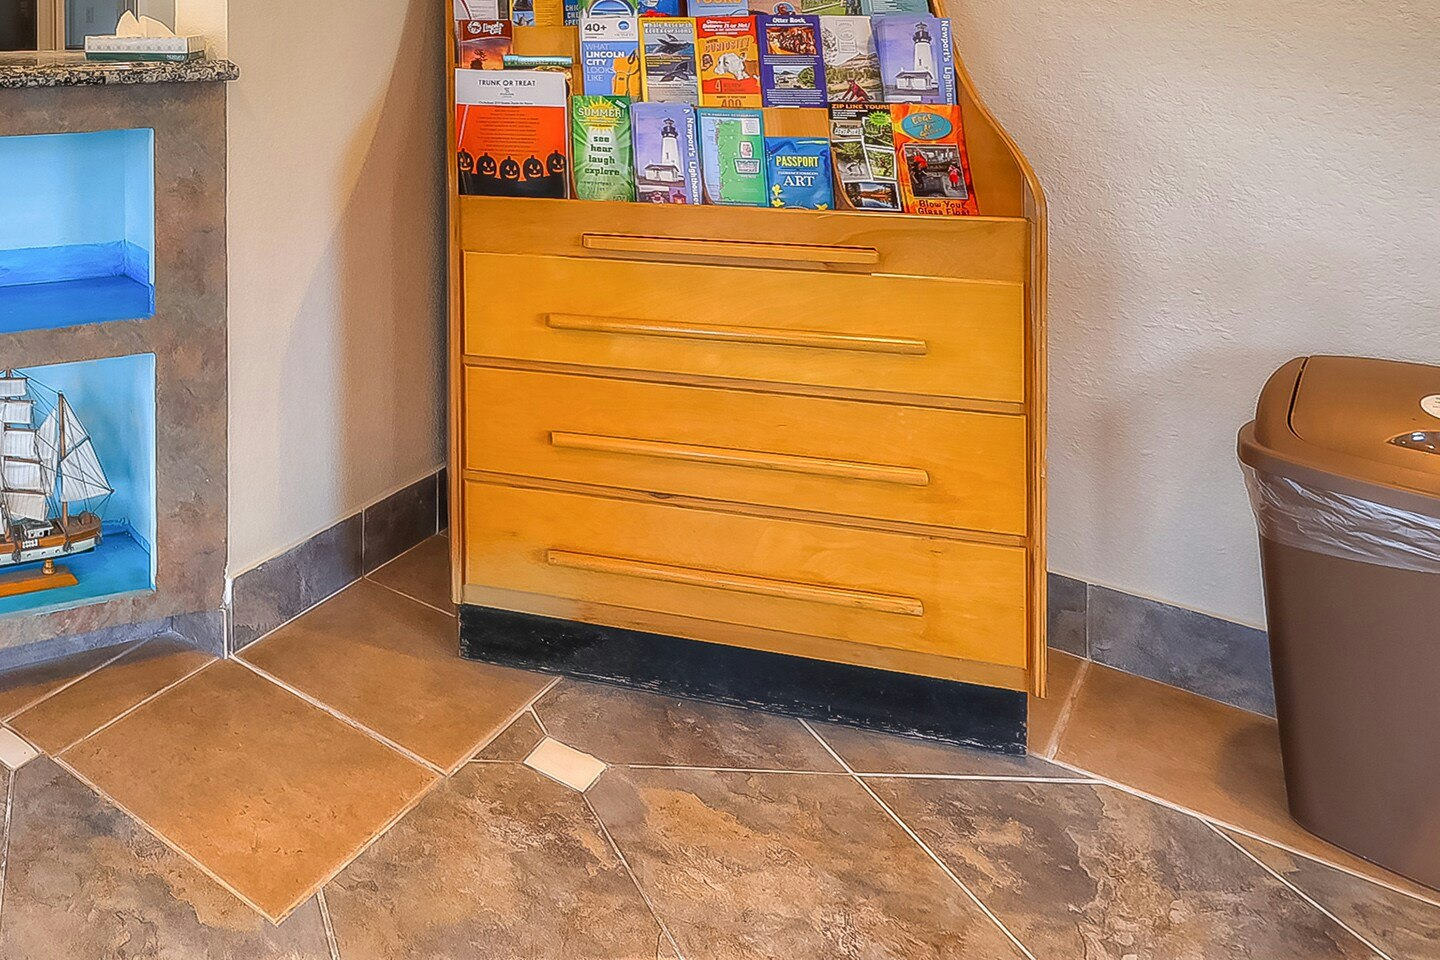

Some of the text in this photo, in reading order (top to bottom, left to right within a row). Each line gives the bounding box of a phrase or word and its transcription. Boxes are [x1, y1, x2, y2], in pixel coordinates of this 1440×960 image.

[584, 23, 608, 32] 40+
[941, 20, 954, 105] Newport's Lighthou
[478, 79, 501, 87] TRUNK
[502, 79, 514, 87] OR
[721, 99, 742, 107] 400
[578, 107, 625, 118] SUMMER!
[686, 117, 696, 158] Newport's
[590, 144, 613, 153] hear
[588, 155, 616, 165] laugh
[776, 156, 819, 167] PASSPORT
[585, 167, 620, 176] explore
[783, 176, 815, 186] ART
[943, 200, 967, 208] Your
